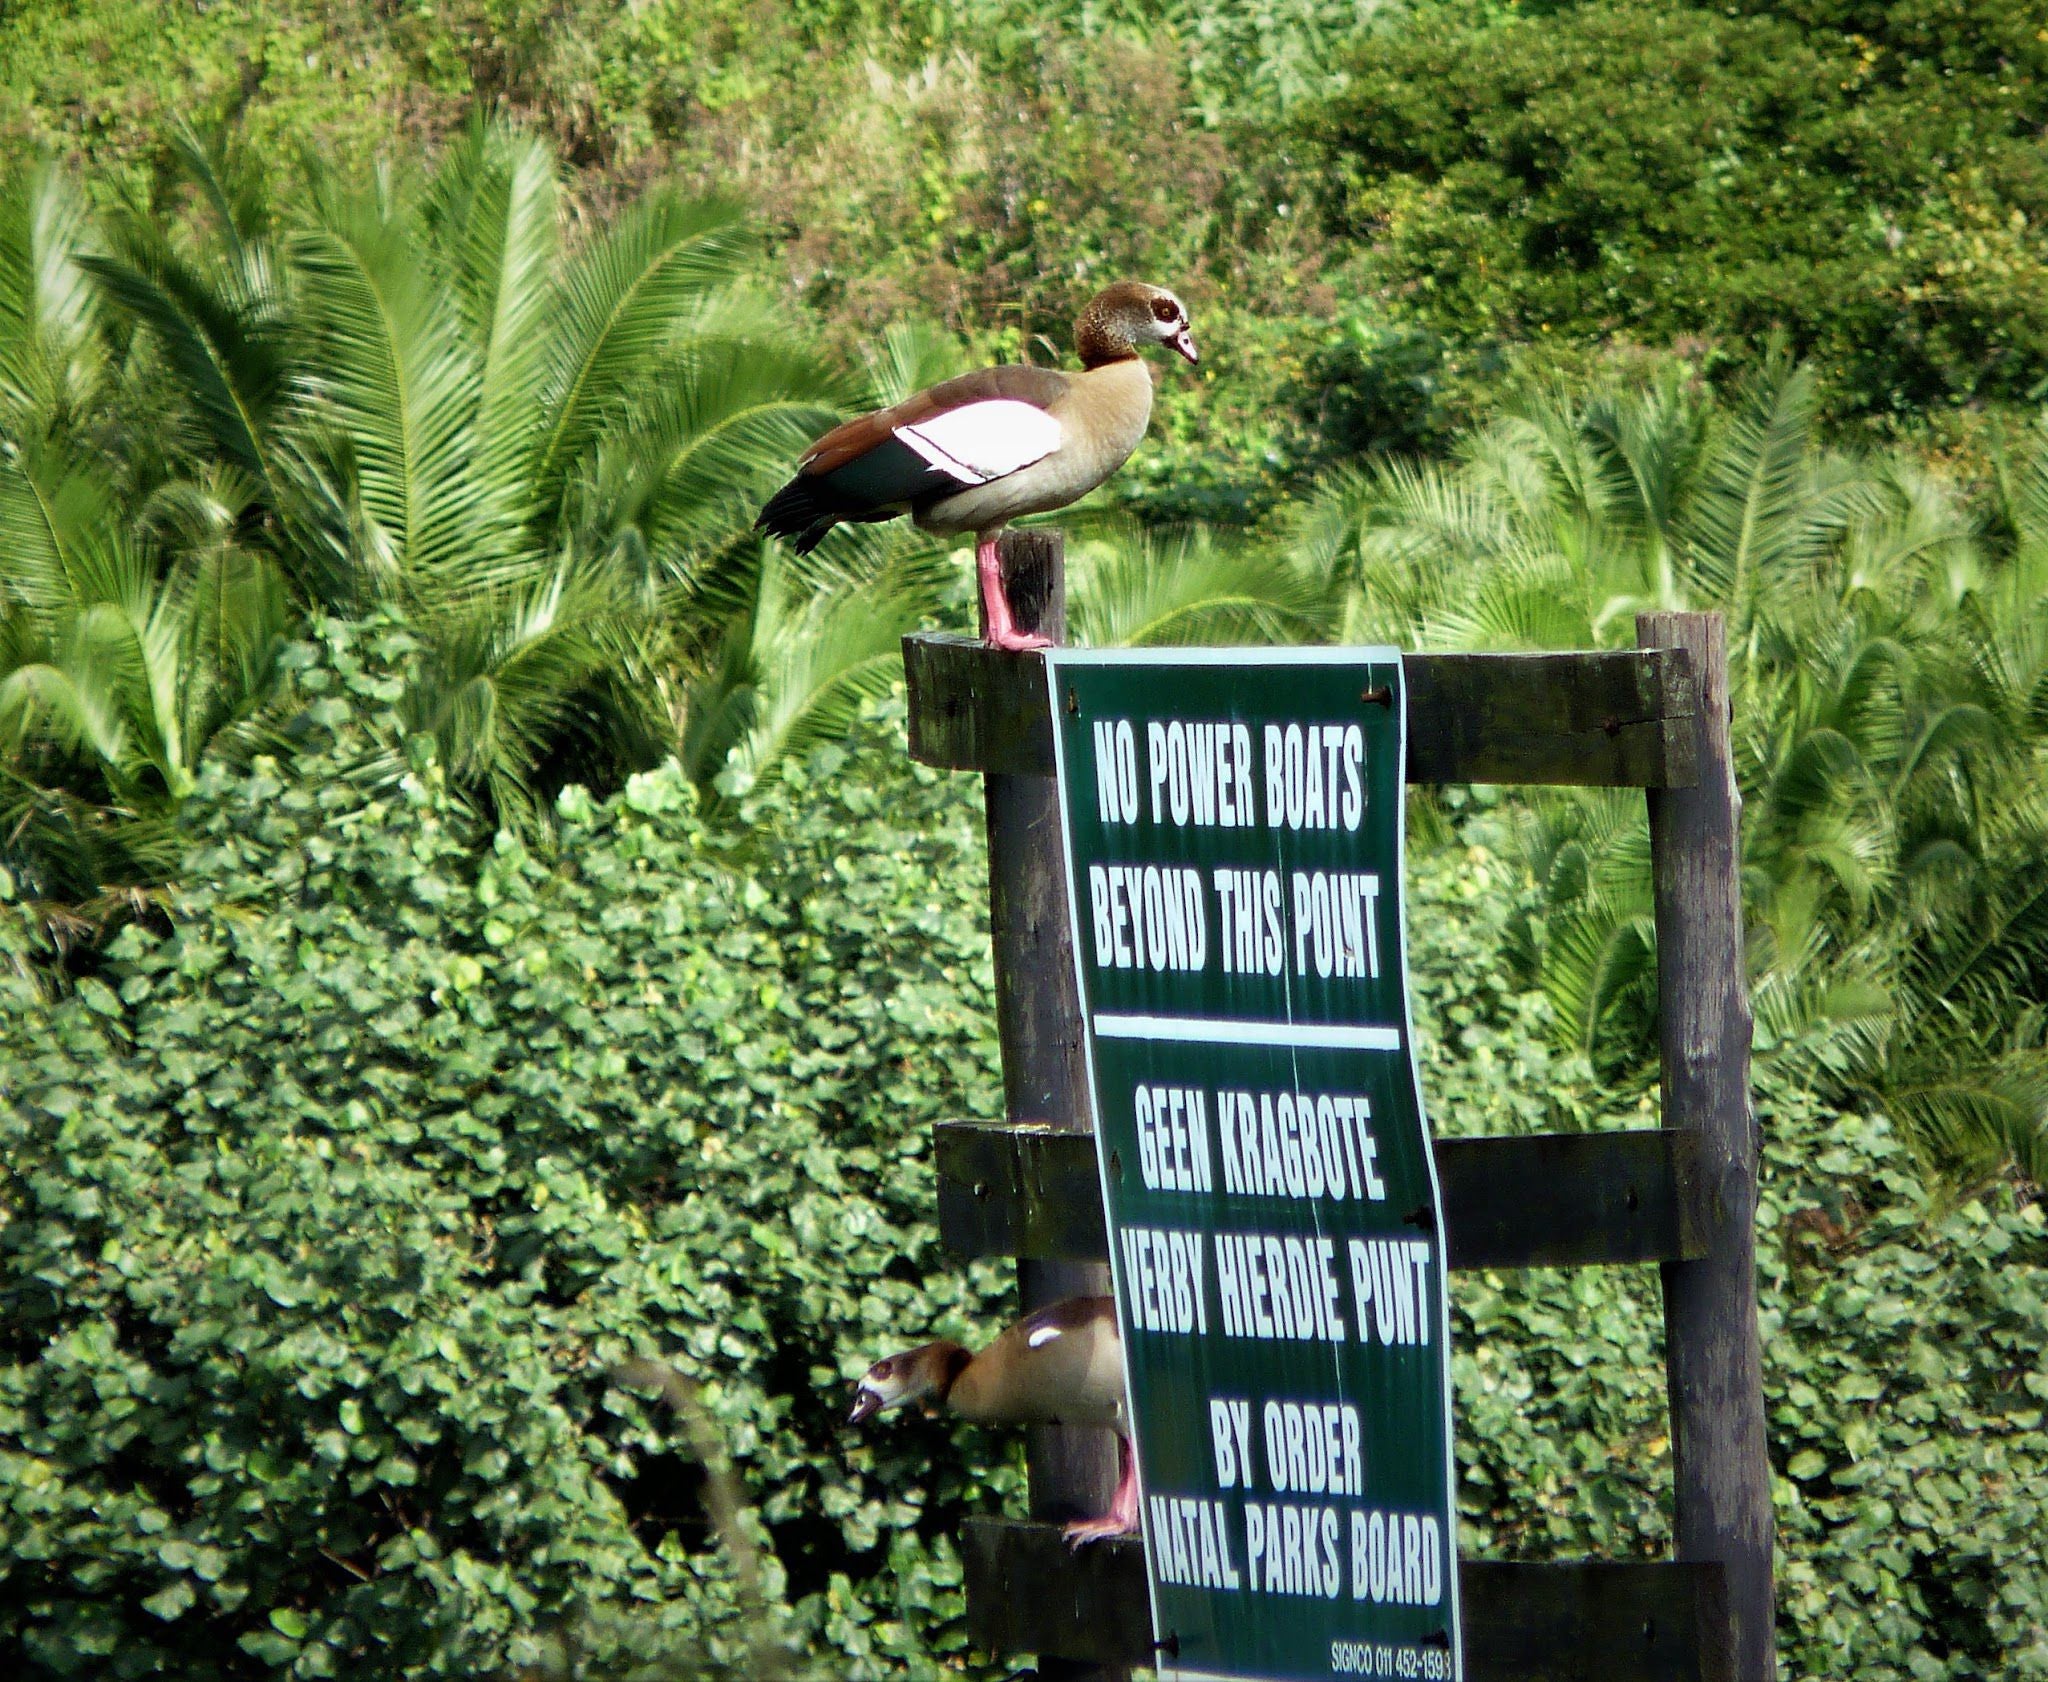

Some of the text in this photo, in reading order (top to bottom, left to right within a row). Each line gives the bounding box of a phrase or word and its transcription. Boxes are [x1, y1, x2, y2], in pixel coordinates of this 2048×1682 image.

[1093, 720, 1363, 832] NO POWER BOATS
[1089, 865, 1379, 979] BEYOND THIS POINT
[1135, 1085, 1385, 1201] GEEN KRAGBOTE
[1121, 1227, 1430, 1346] VERBY HIERDIE PUNT
[1210, 1400, 1362, 1496] BY ORDER
[1150, 1496, 1441, 1605] NATAL PARKS BOARD
[1331, 1641, 1373, 1675] SIGNCO
[1376, 1645, 1393, 1677] 011
